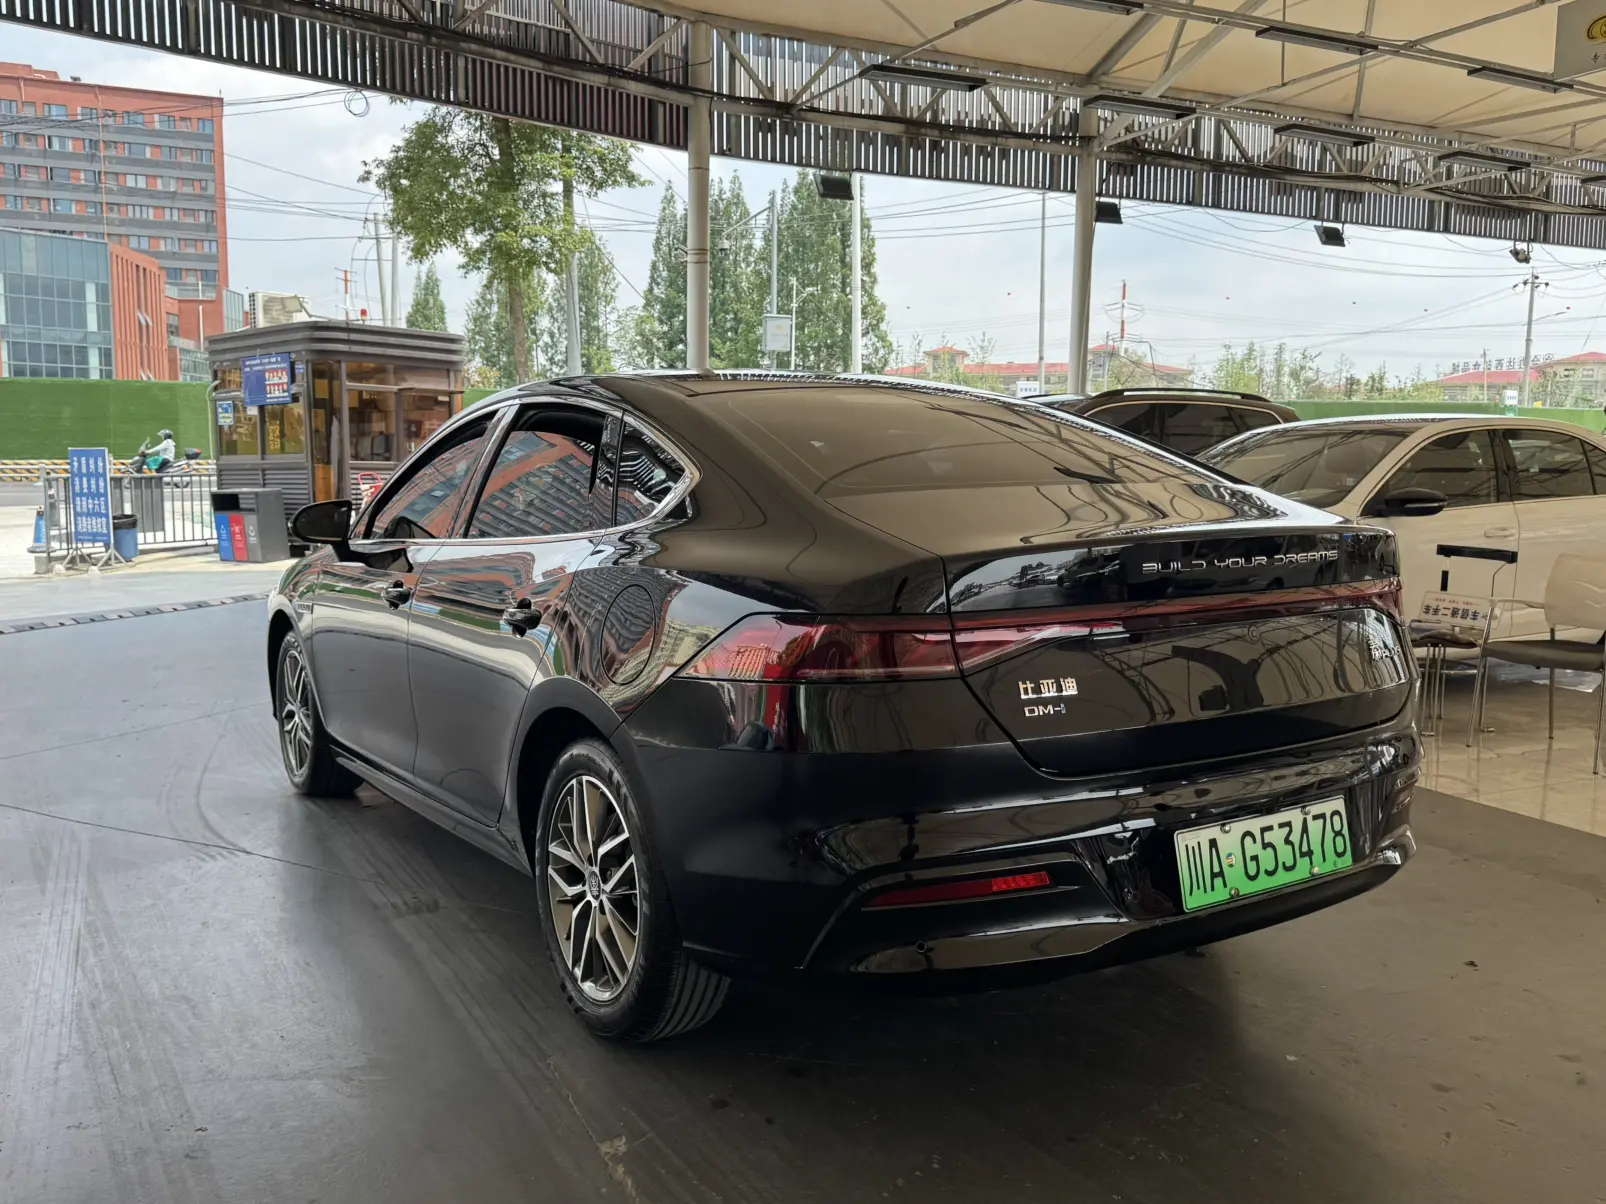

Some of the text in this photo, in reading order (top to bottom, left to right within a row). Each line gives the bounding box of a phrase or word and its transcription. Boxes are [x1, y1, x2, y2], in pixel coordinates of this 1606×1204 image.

[1142, 550, 1339, 574] BUILD YOUR DREAMS
[1018, 677, 1079, 699] 比亚迪
[1023, 703, 1066, 717] DM-i
